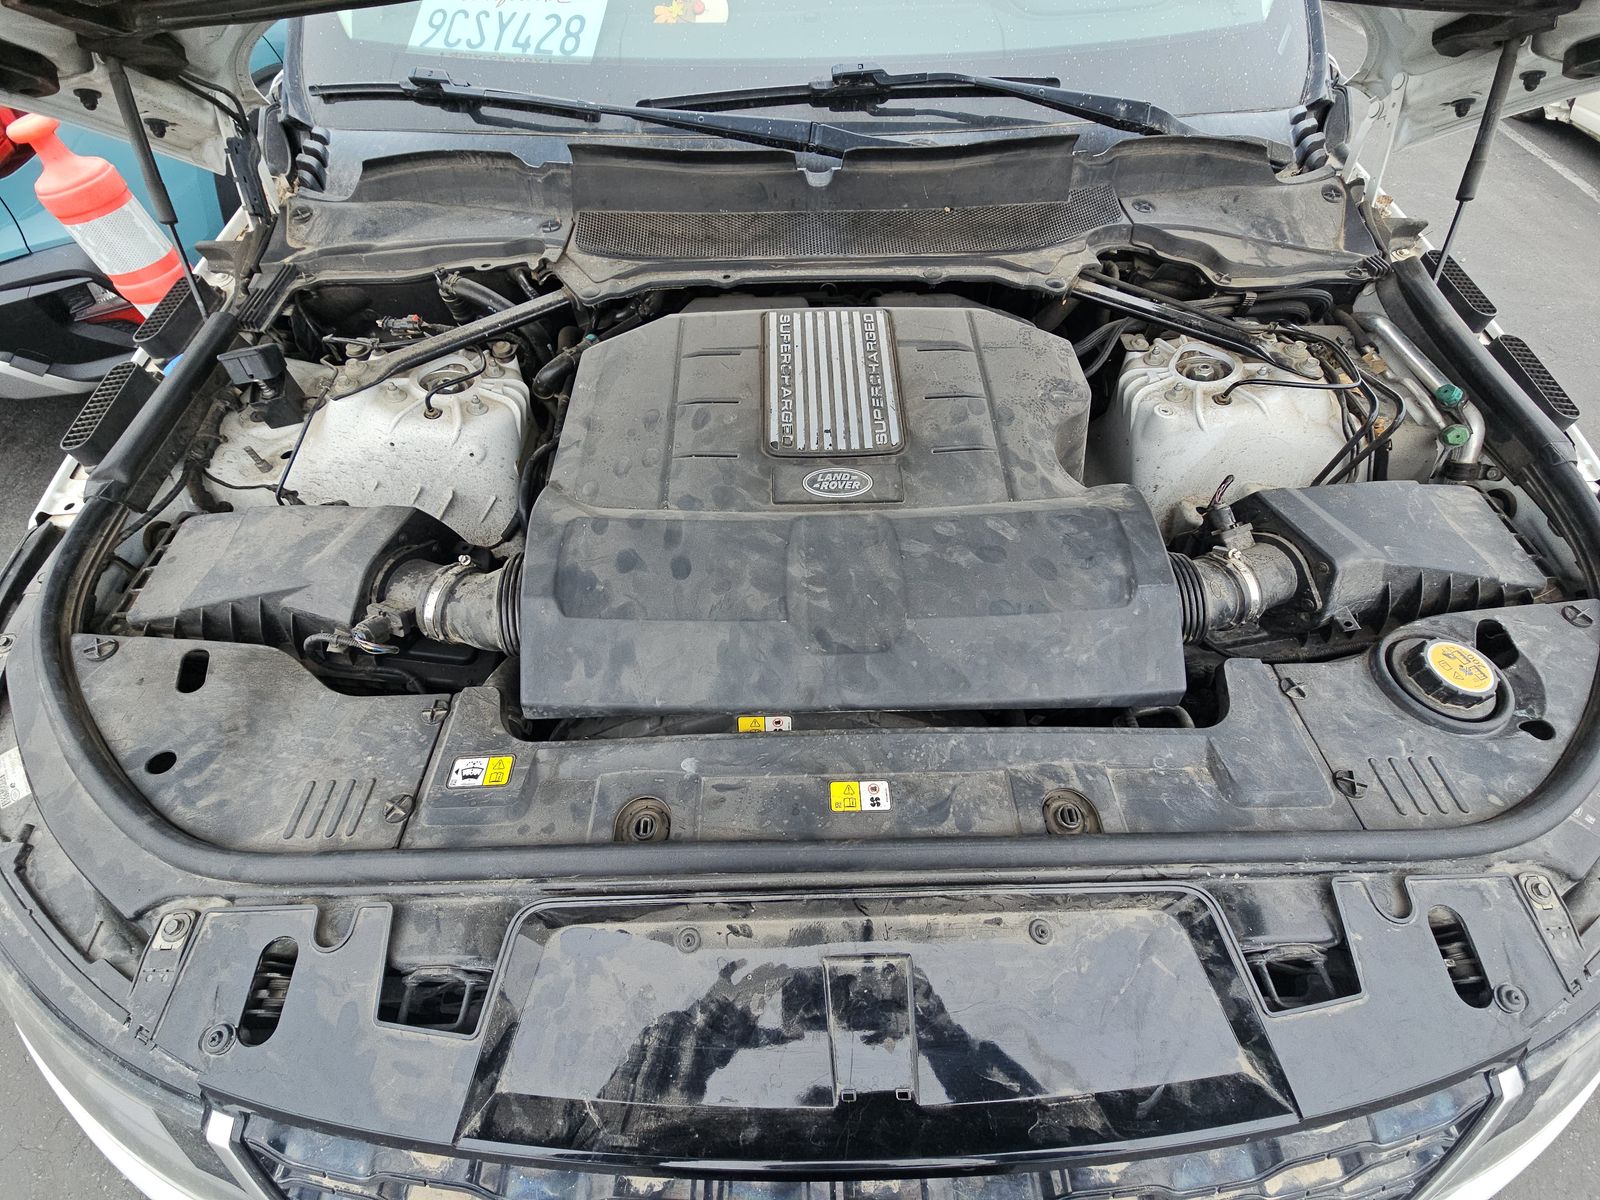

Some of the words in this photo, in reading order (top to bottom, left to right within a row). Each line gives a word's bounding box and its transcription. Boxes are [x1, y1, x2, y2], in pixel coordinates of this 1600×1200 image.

[420, 8, 586, 56] 9CSY428
[779, 314, 794, 448] SUPERCHARGED
[863, 313, 888, 445] SUPERCHARGED
[817, 473, 851, 482] LAND
[820, 480, 861, 490] ROVER
